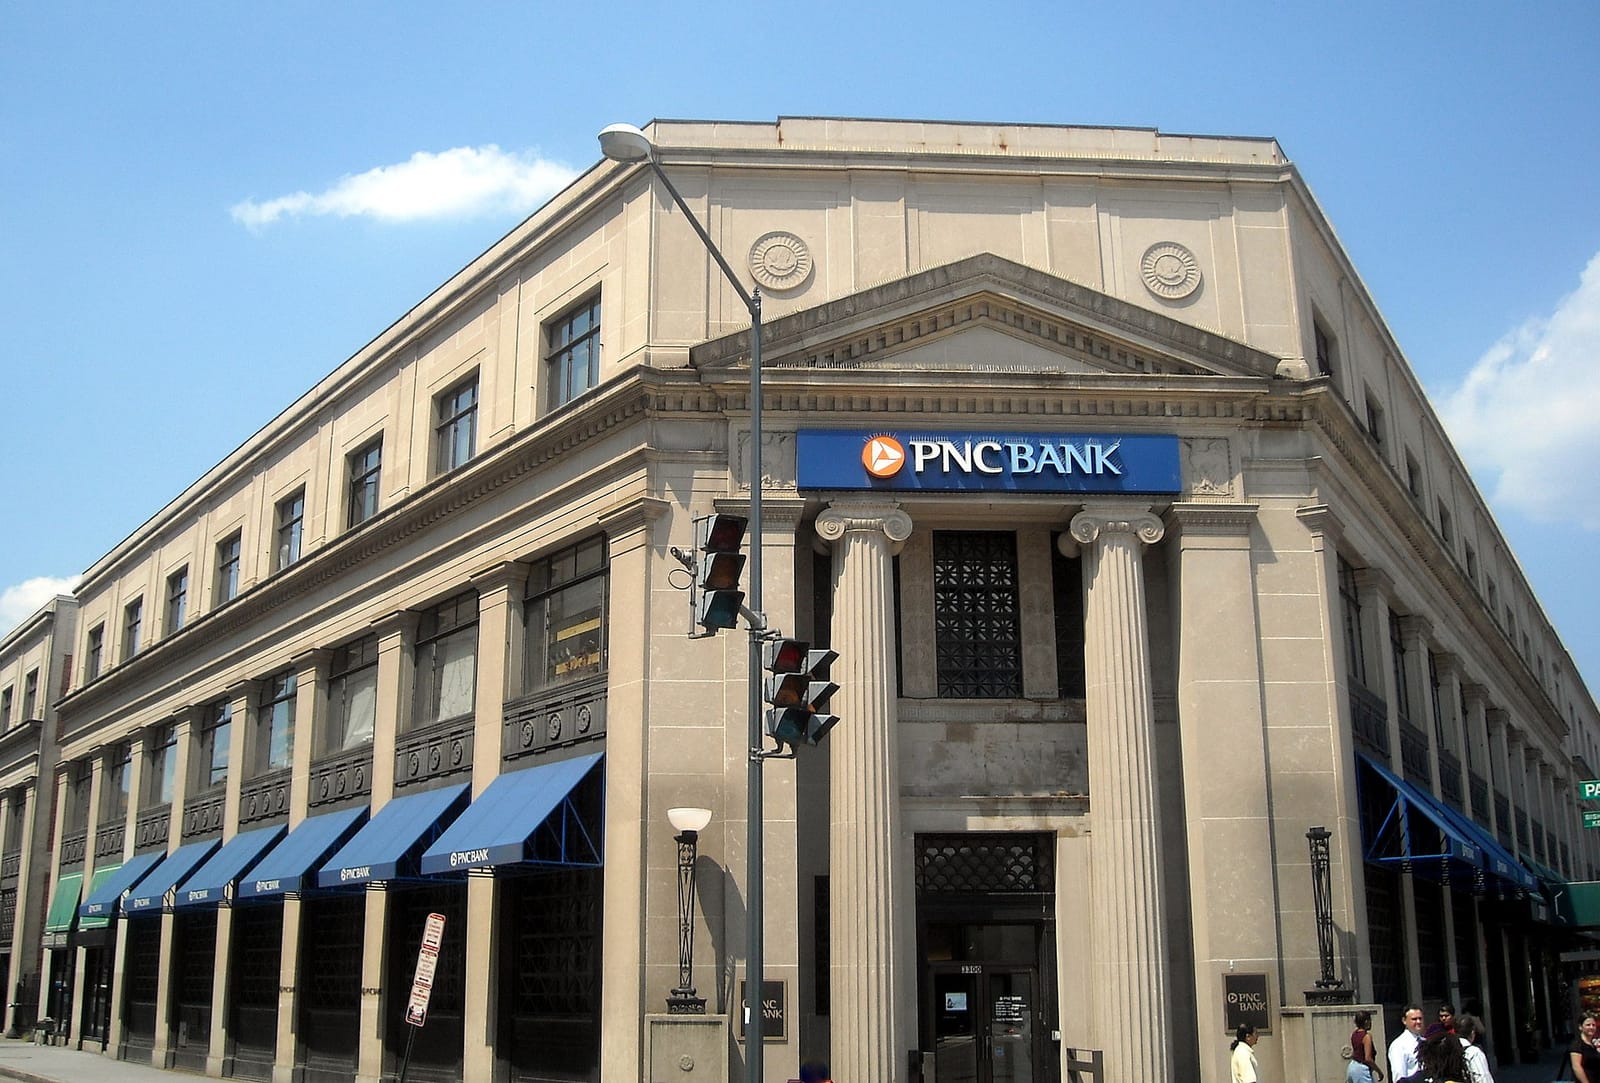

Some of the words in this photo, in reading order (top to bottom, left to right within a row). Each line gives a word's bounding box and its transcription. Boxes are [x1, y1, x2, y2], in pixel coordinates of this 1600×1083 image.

[1239, 993, 1260, 1002] PNC
[762, 1000, 777, 1009] NC
[1239, 1002, 1266, 1011] BANK
[762, 1009, 783, 1019] ANK
